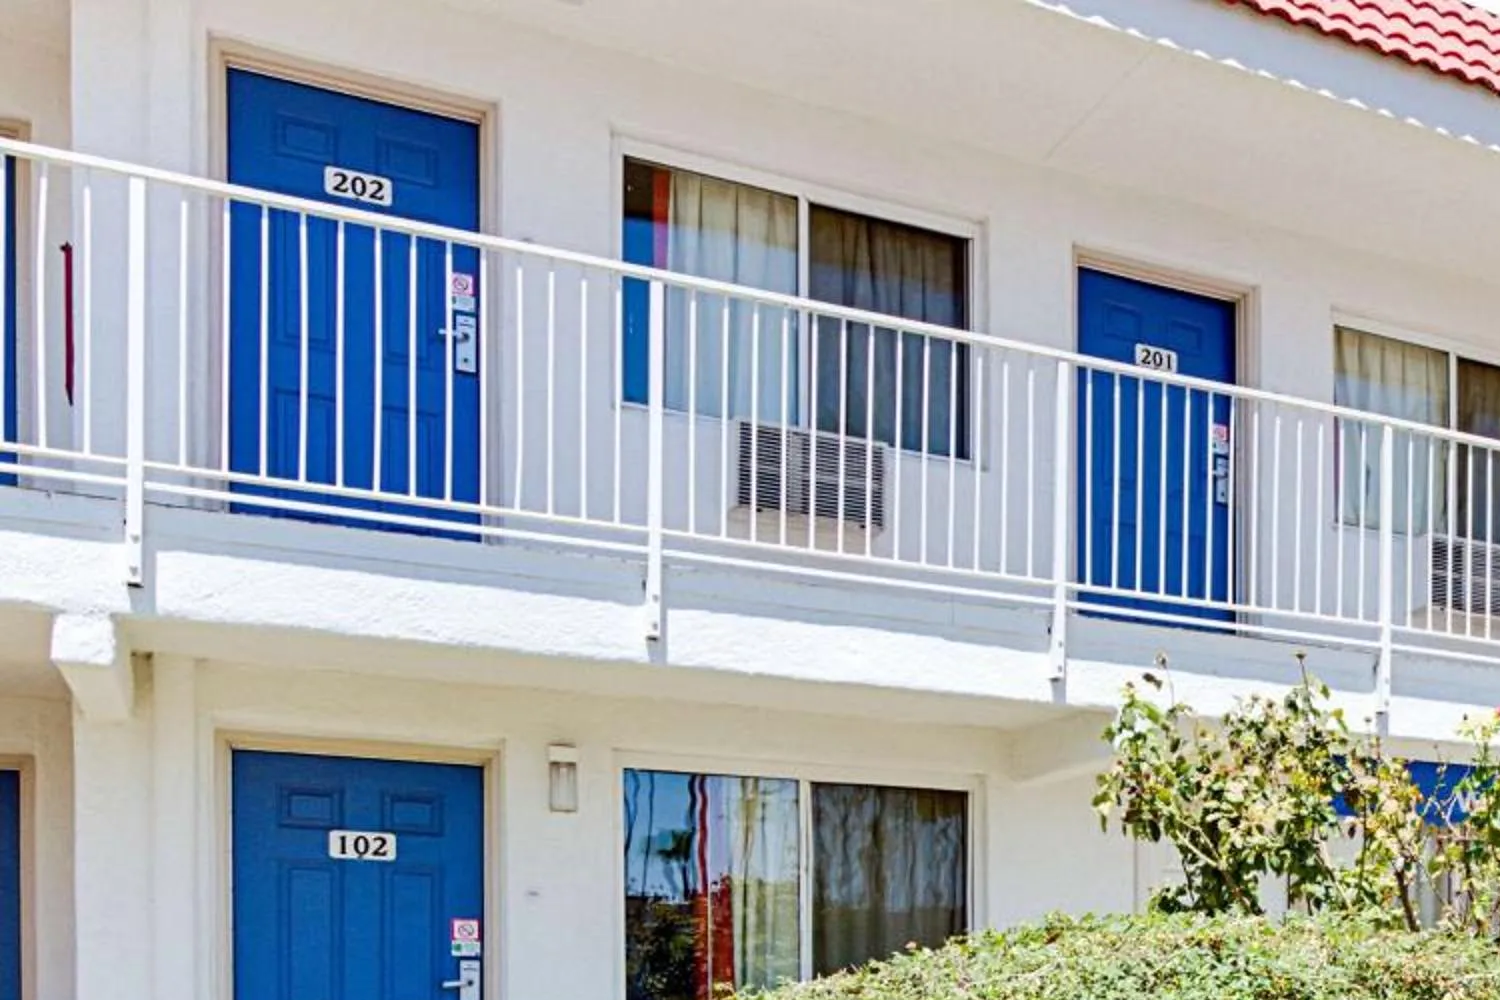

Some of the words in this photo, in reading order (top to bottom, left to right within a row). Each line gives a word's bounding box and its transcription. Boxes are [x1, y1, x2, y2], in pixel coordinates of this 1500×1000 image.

[332, 171, 385, 201] 202
[1141, 348, 1172, 370] 201
[339, 835, 388, 857] 102
